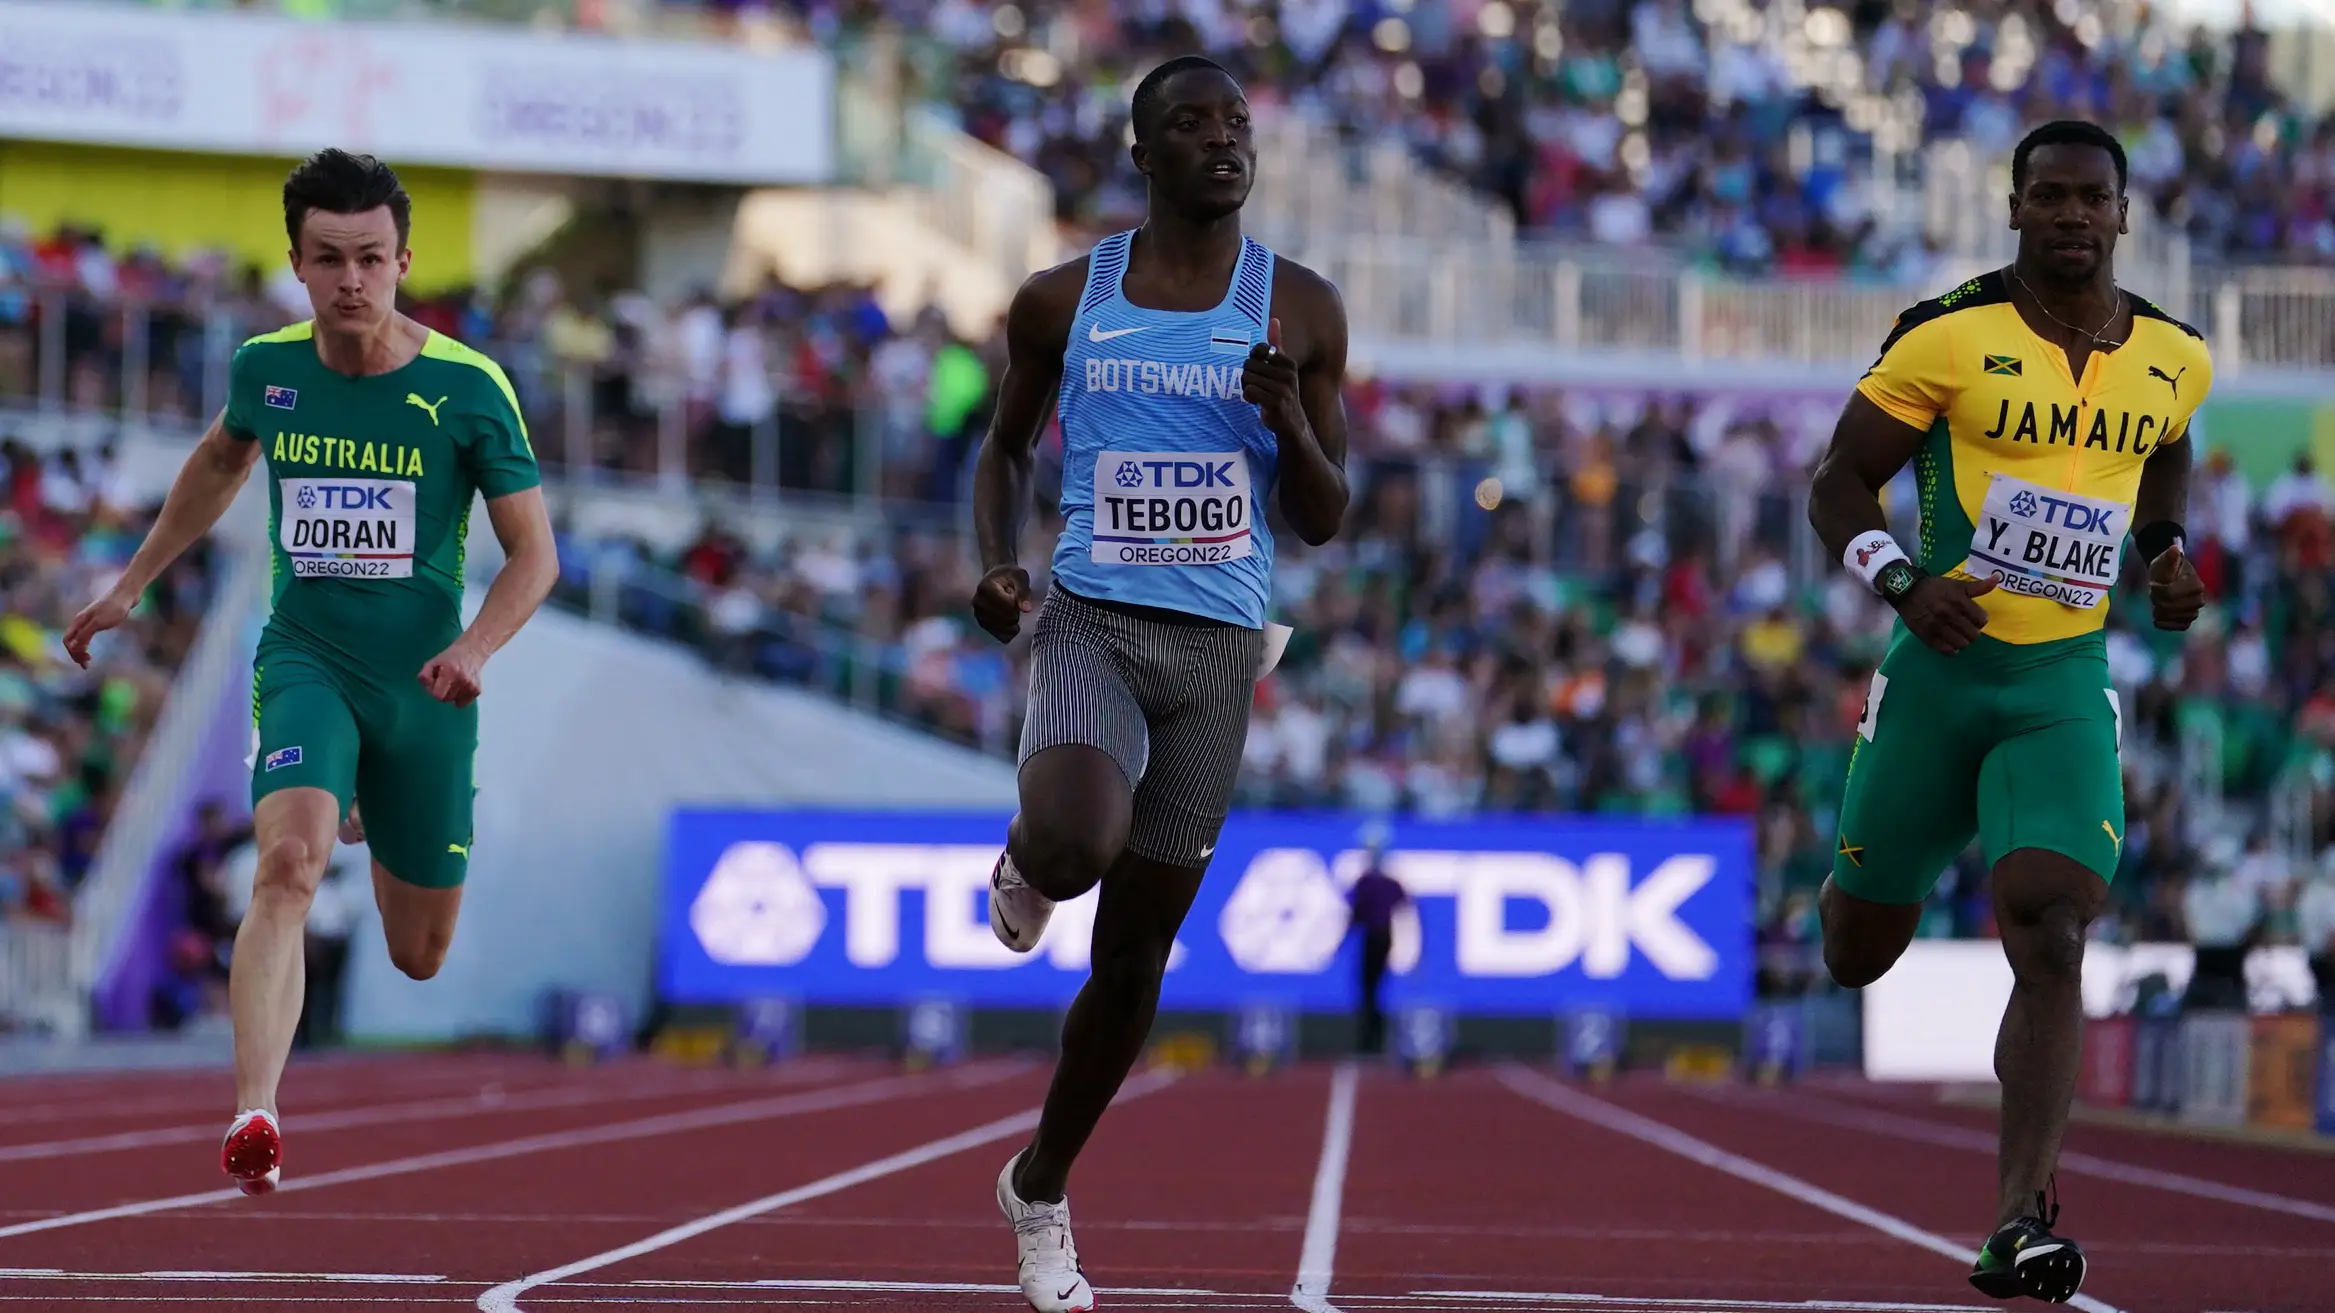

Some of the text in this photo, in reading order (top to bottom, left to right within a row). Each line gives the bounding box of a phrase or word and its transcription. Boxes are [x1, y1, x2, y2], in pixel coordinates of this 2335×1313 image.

[1085, 358, 1244, 401] BOTSWANA
[273, 431, 424, 477] AUSTRALIA
[1143, 461, 1235, 488] TDK
[316, 486, 393, 510] TDK
[1105, 495, 1243, 532] TEBOGO
[2040, 496, 2114, 536] TDK
[292, 518, 397, 550] DORAN
[1988, 516, 2115, 578] Y. BLAKE
[294, 560, 390, 576] OREGON22
[1119, 544, 1231, 563] OREGON22
[1990, 568, 2094, 607] OREGON22
